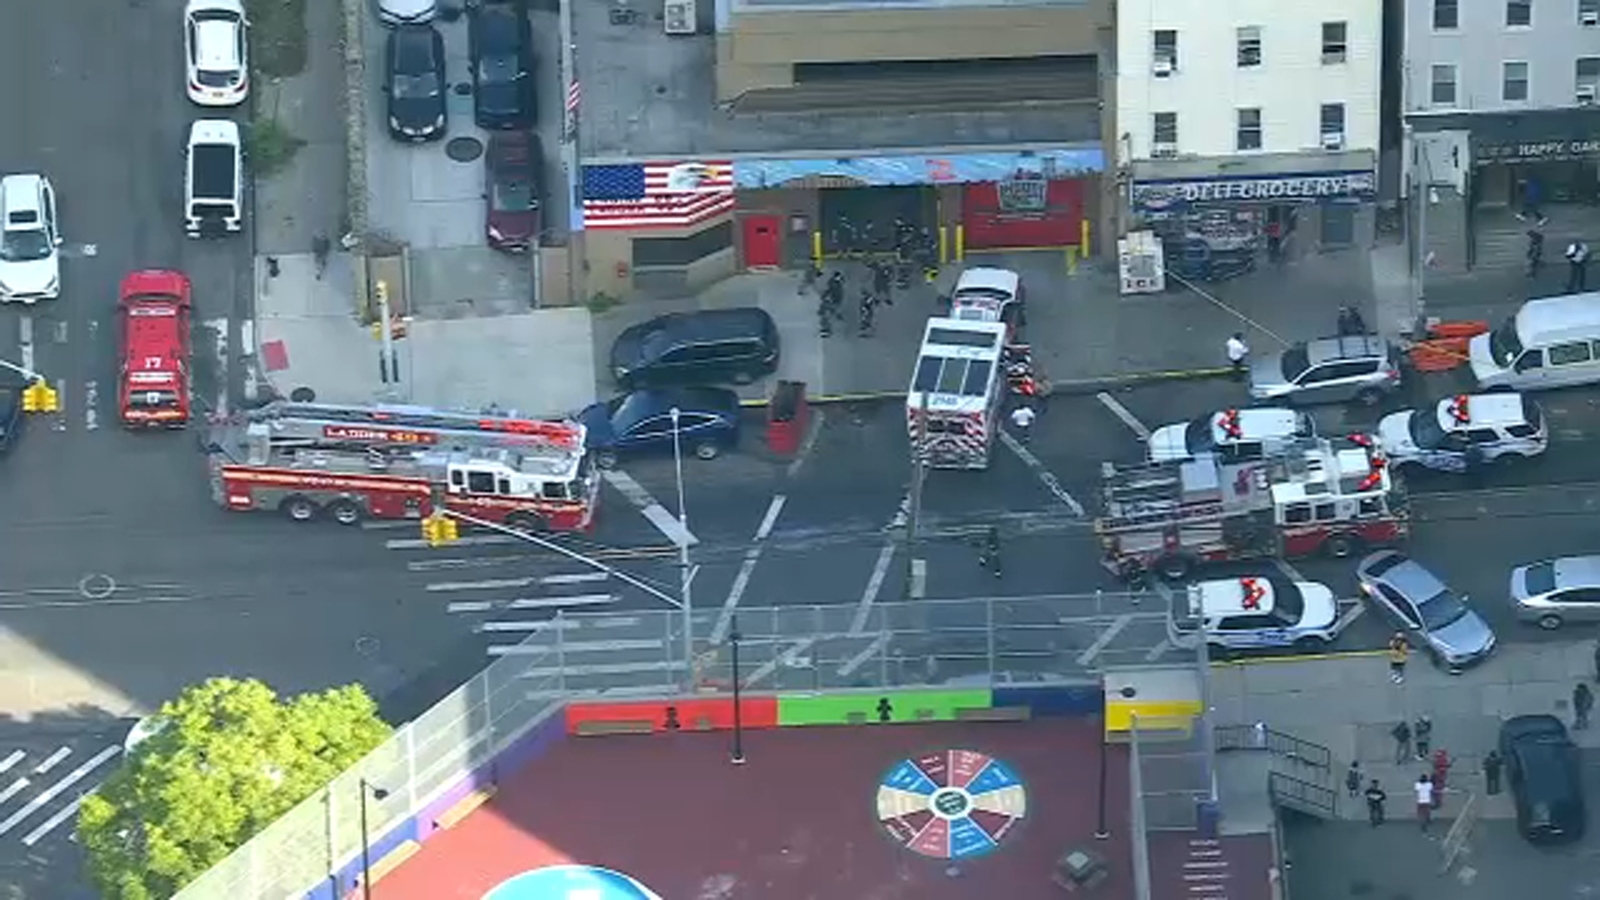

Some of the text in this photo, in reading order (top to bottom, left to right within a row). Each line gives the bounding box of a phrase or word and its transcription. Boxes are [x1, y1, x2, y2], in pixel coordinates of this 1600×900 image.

[1519, 142, 1565, 155] HAPPY
[1184, 179, 1231, 200] DELI
[1241, 177, 1341, 198] GROCERY
[144, 357, 161, 369] 17
[325, 427, 389, 440] LADDER
